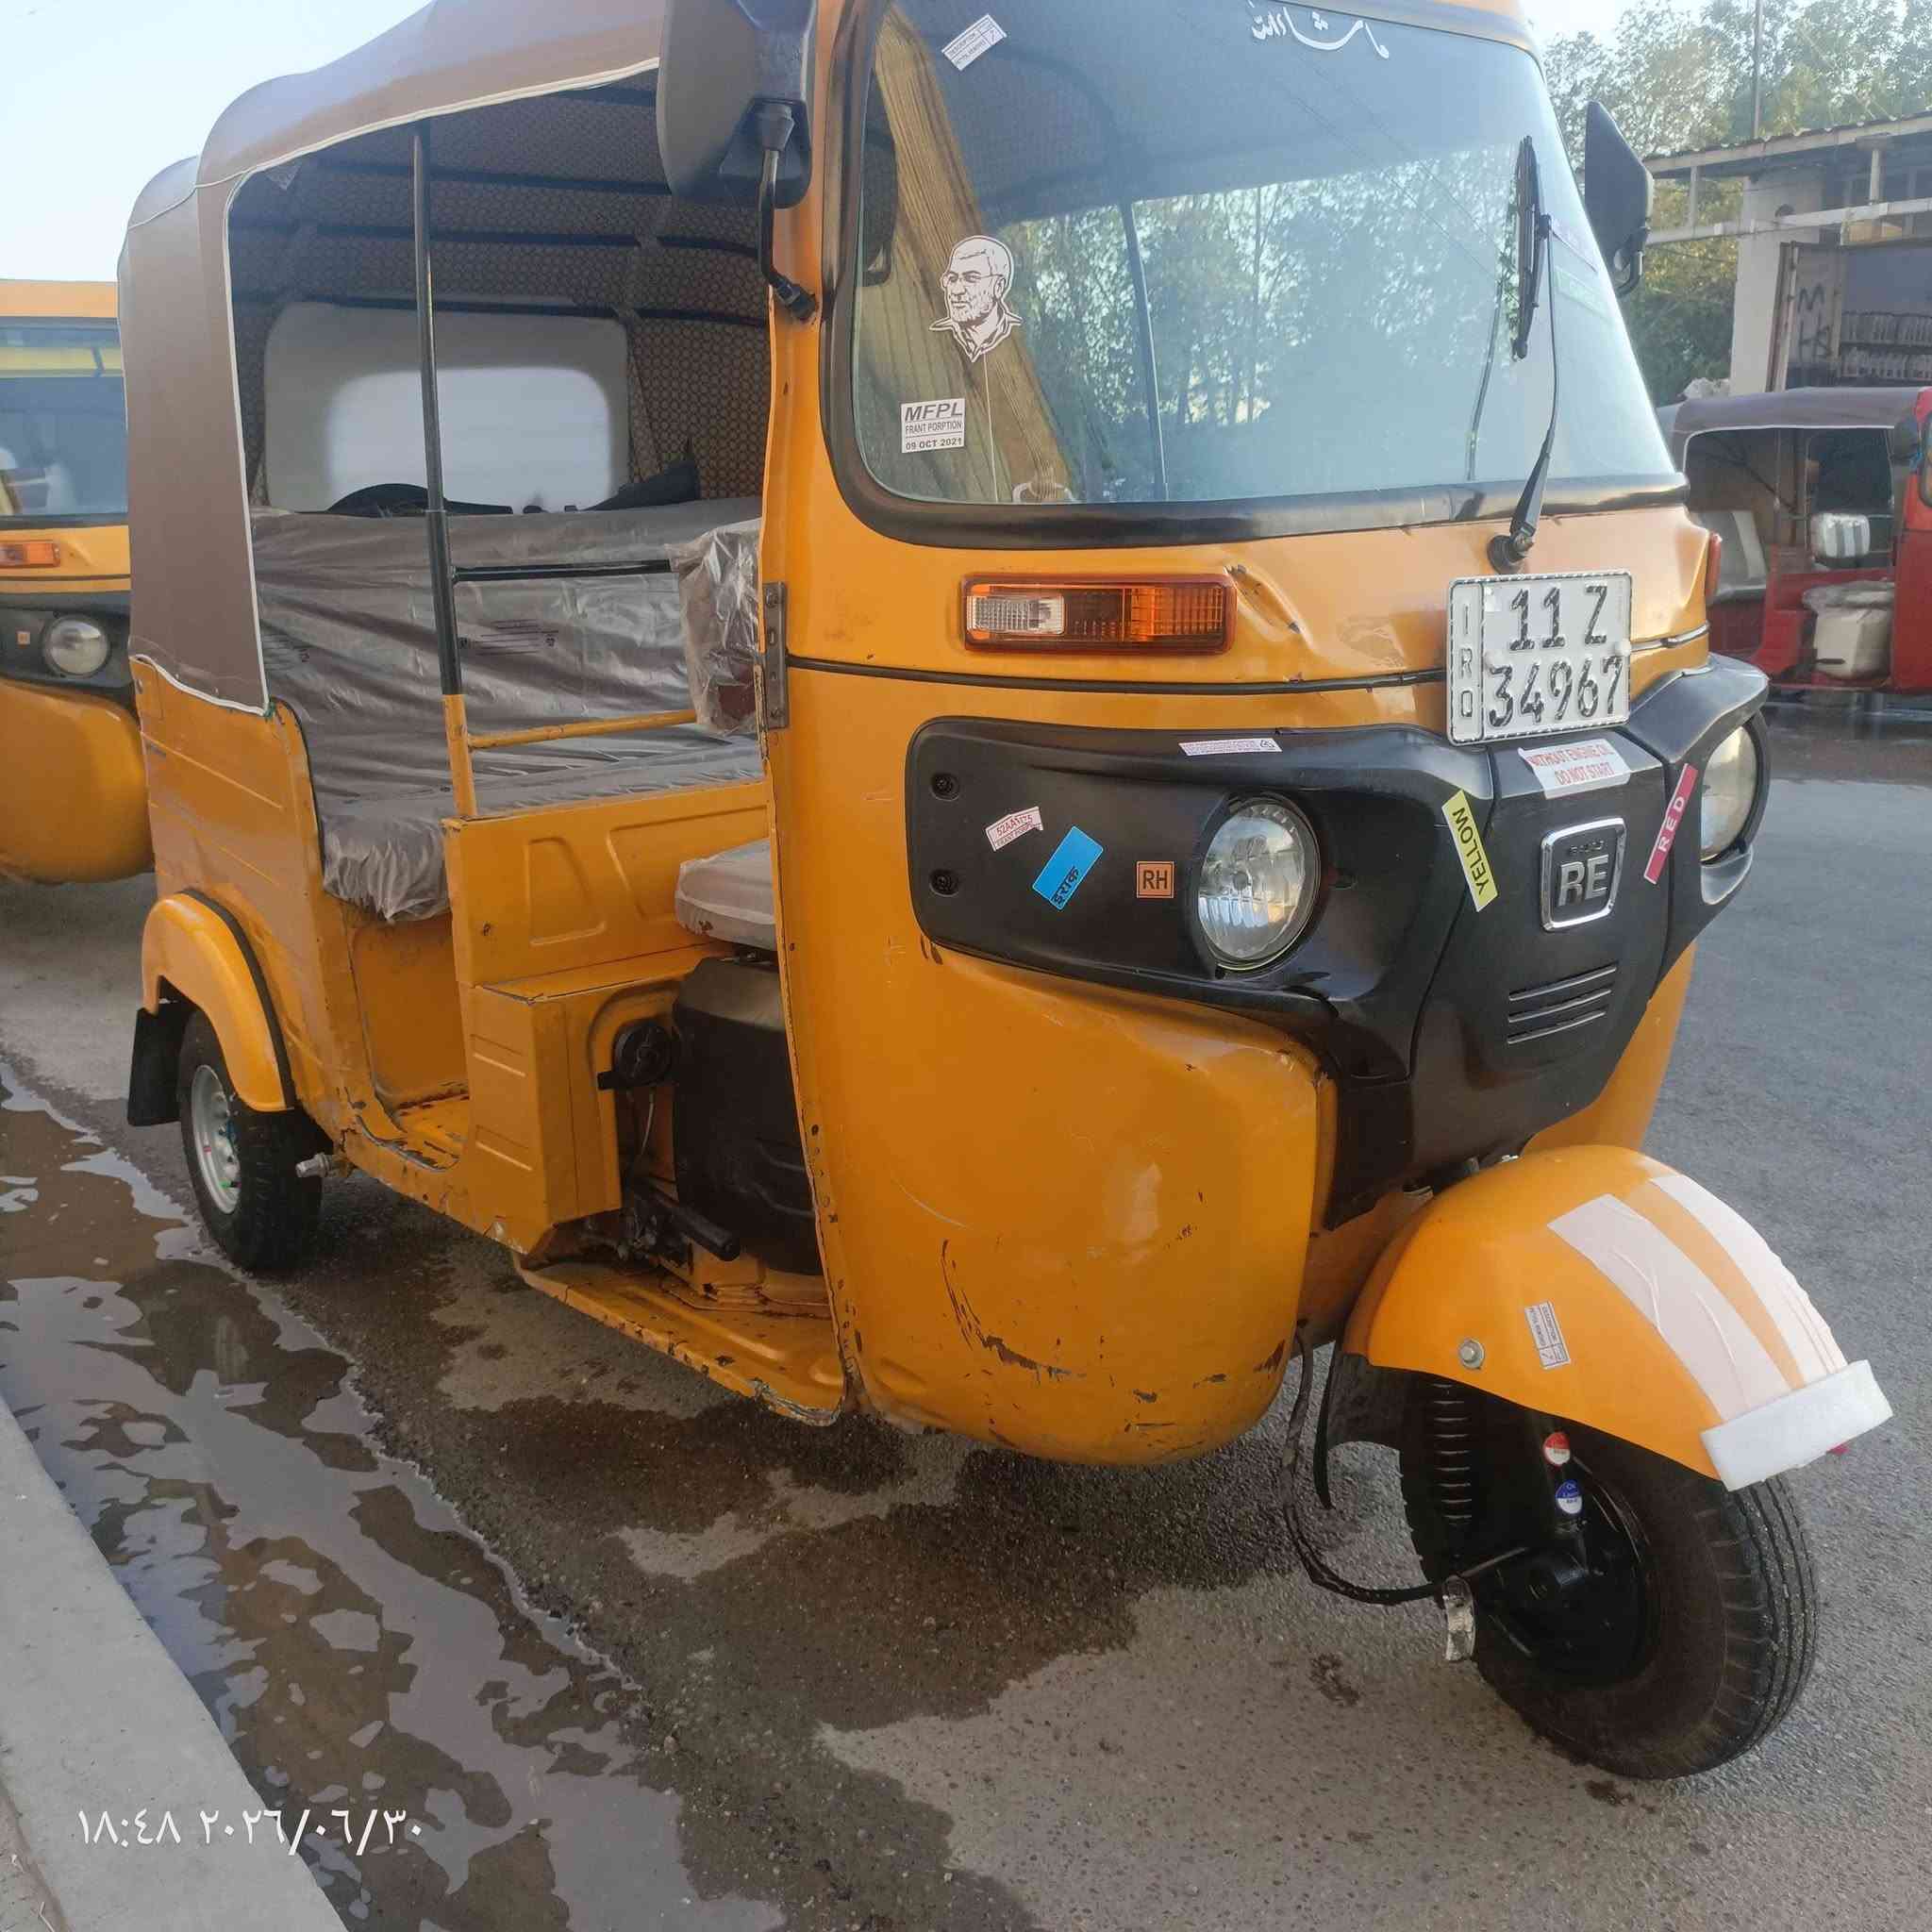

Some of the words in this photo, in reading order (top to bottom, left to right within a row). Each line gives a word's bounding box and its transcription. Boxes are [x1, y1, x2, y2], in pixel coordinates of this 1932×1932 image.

[906, 403, 963, 421] MFPL
[906, 442, 917, 451] 09
[920, 440, 937, 448] OCT
[940, 438, 962, 446] 2021
[1509, 587, 1566, 651] 11
[1584, 585, 1607, 645] Z
[1488, 656, 1624, 727] 34967
[1453, 807, 1487, 895] YELLOW
[1657, 796, 1685, 853] RED
[1142, 870, 1168, 890] RH
[1557, 854, 1609, 907] RE
